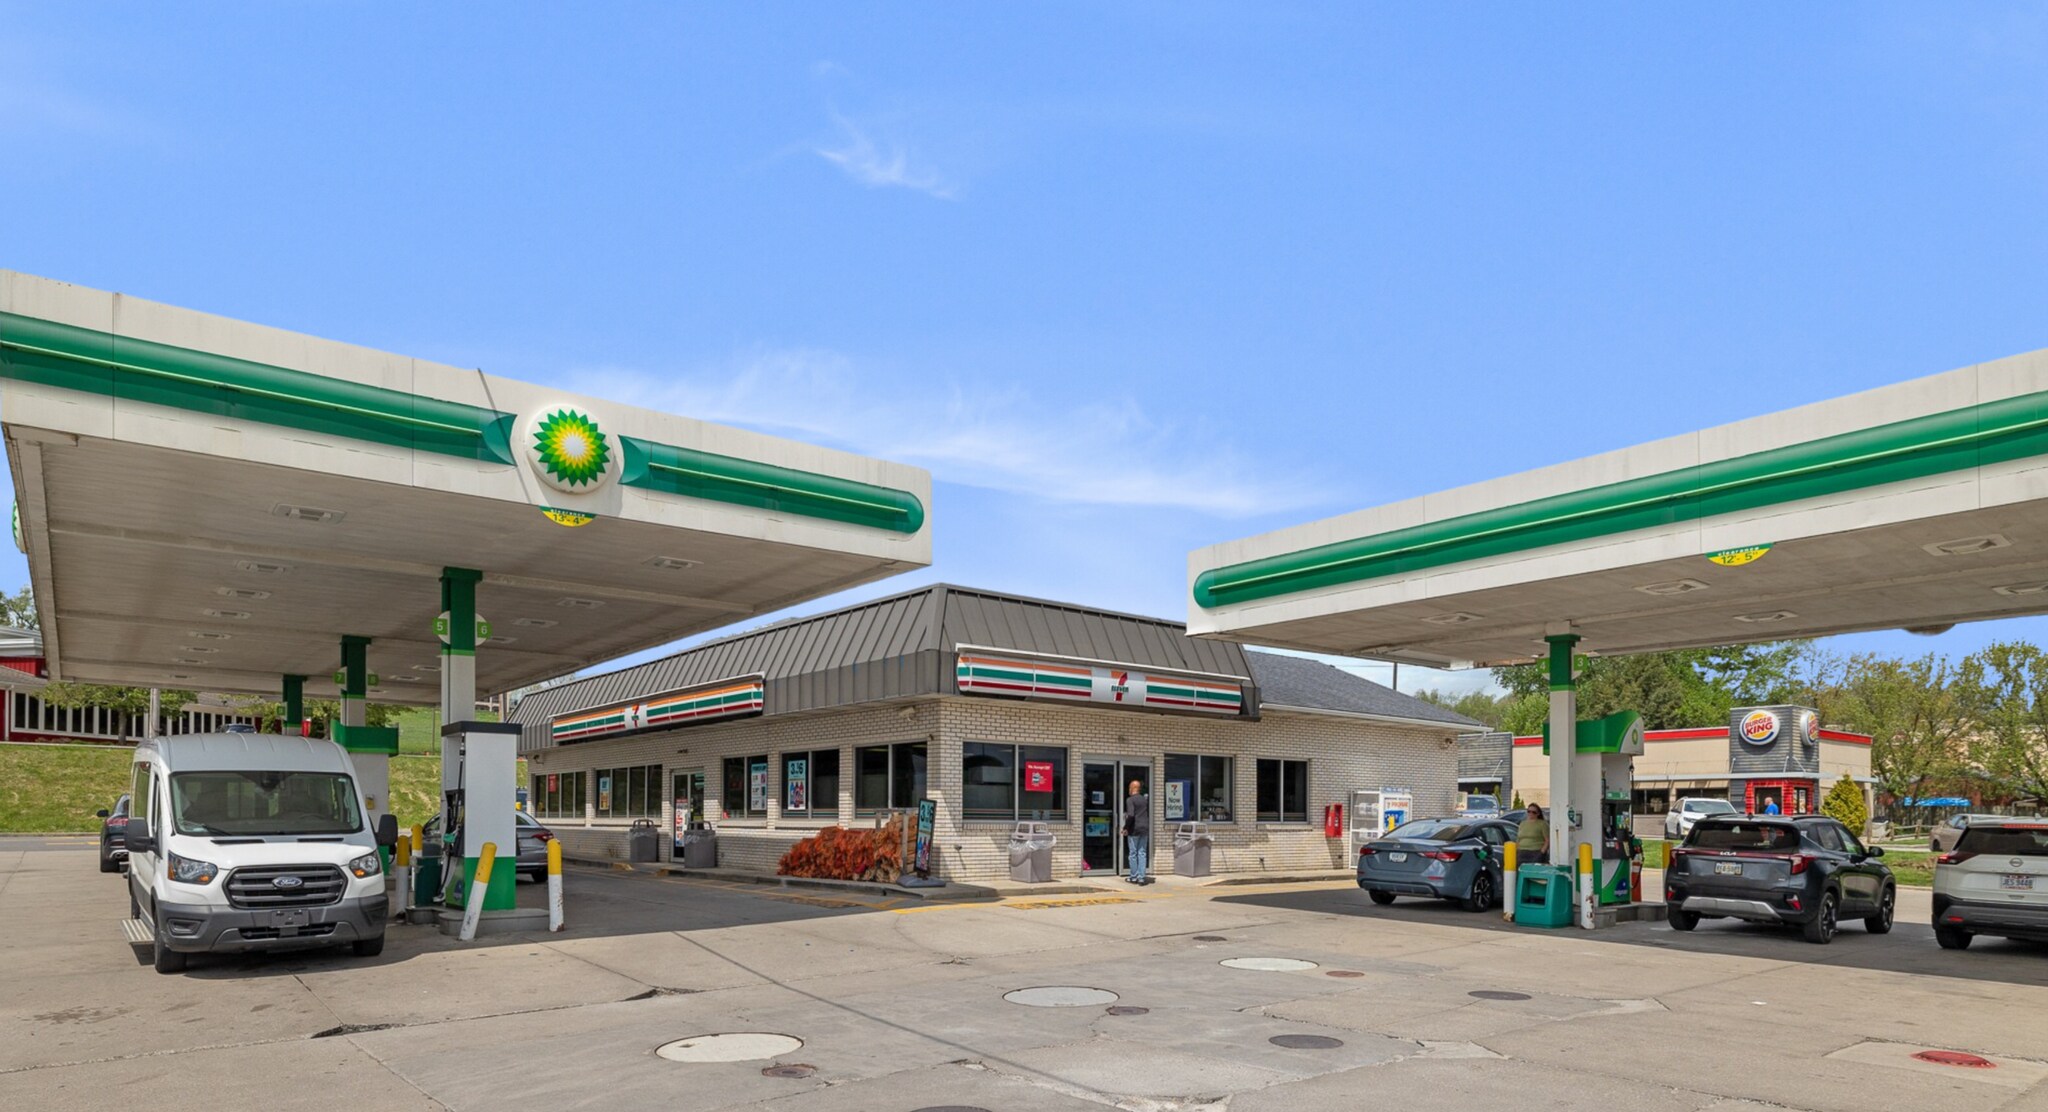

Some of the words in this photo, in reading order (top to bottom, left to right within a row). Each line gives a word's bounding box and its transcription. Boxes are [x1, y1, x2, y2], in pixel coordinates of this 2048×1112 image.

[436, 621, 444, 632] 5
[481, 625, 488, 635] 6
[1744, 716, 1773, 729] BURGER
[1745, 722, 1774, 737] KING
[1167, 804, 1183, 812] Hiring
